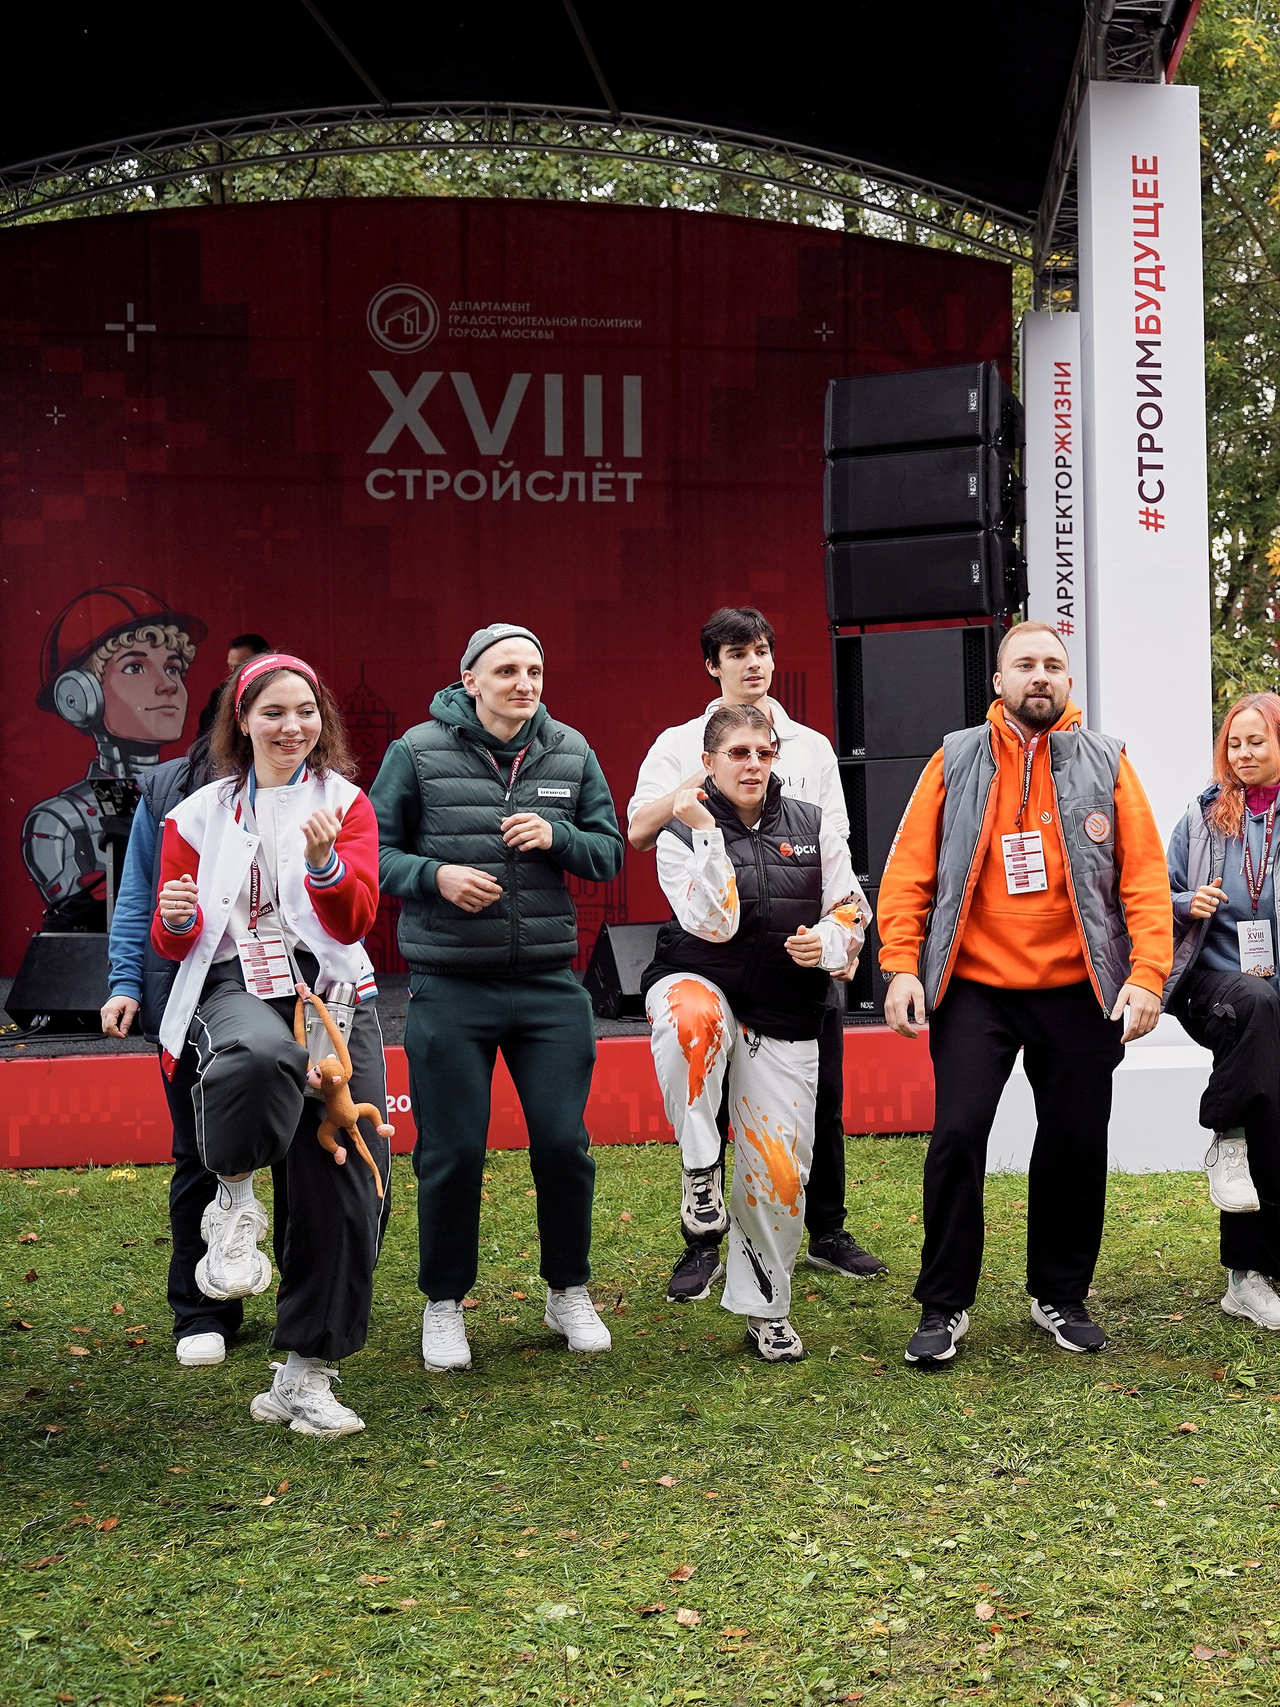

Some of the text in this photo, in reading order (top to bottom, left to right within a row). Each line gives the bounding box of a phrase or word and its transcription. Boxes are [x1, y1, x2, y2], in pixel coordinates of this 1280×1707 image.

[449, 301, 531, 312] ДЕПАРТАМЕНТ
[449, 315, 642, 328] ГРАДОСТРОИТЕЛЬНОЙ ПОЛИТИКИ
[449, 329, 554, 339] ГОРОДА МОСКВЫ
[1132, 154, 1166, 533] #СТРОИМБУДУЩЕЕ
[365, 370, 642, 457] XVIII
[365, 460, 642, 502] СТРОЙСЛЁТ
[969, 476, 977, 496] NEXO
[1054, 361, 1075, 637] #АРХИТЕКТОРЖИЗНИ
[1247, 932, 1265, 940] XVIII
